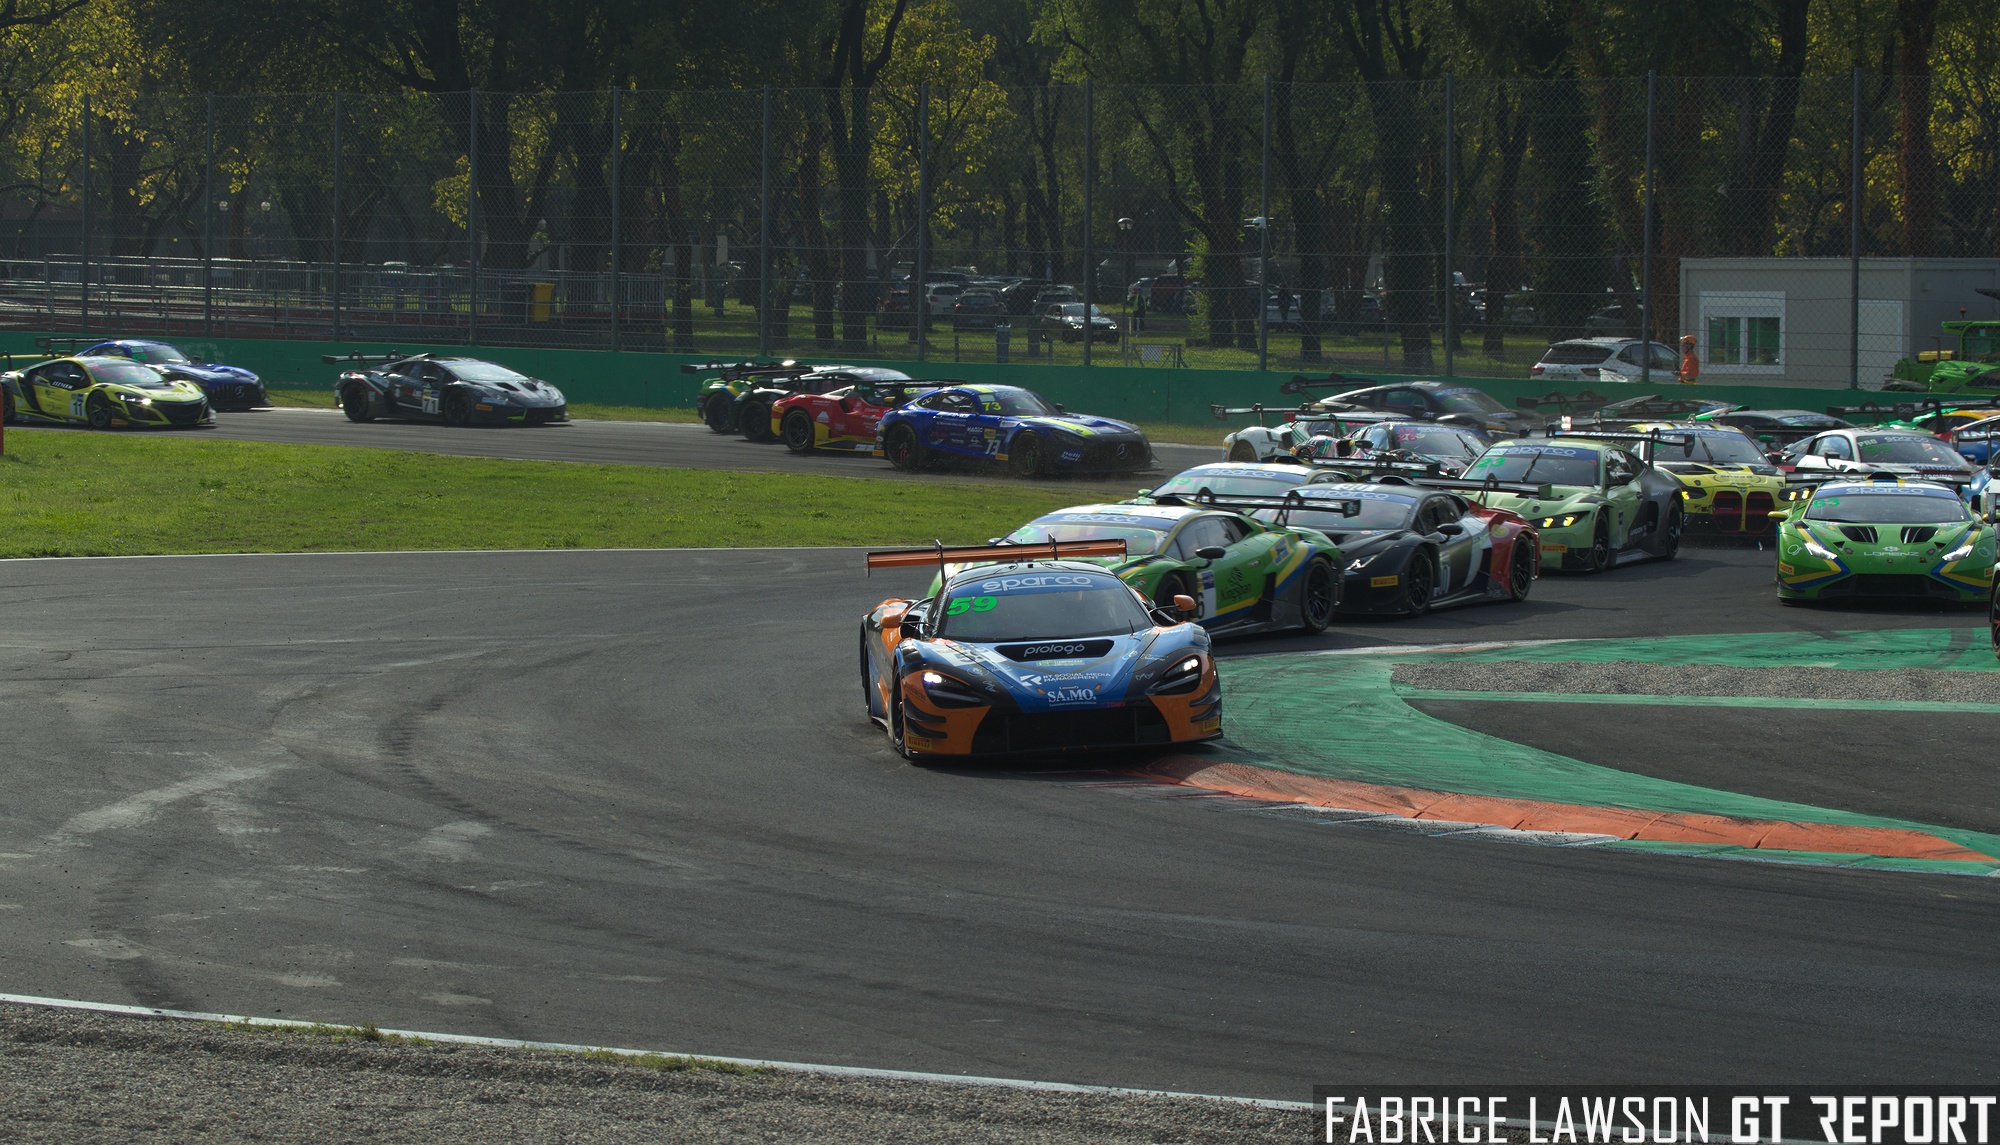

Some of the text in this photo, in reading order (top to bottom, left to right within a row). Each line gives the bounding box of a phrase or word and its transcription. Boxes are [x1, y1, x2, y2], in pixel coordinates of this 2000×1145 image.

[73, 401, 83, 417] 11
[425, 400, 438, 413] 71
[981, 401, 1002, 411] 73
[1397, 433, 1418, 443] 26
[984, 439, 1001, 455] 73
[1506, 446, 1576, 457] sparco
[1475, 457, 1506, 468] 23
[1204, 467, 1278, 478] sparco
[1310, 490, 1390, 500] sparco
[1845, 487, 1925, 495] sparco
[1813, 497, 1840, 508] 63
[1059, 513, 1142, 524] sparco
[982, 575, 1093, 594] sparco
[947, 595, 998, 616] 59
[1043, 675, 1099, 683] MANAGEMENT
[1047, 688, 1097, 703] SA.MO.
